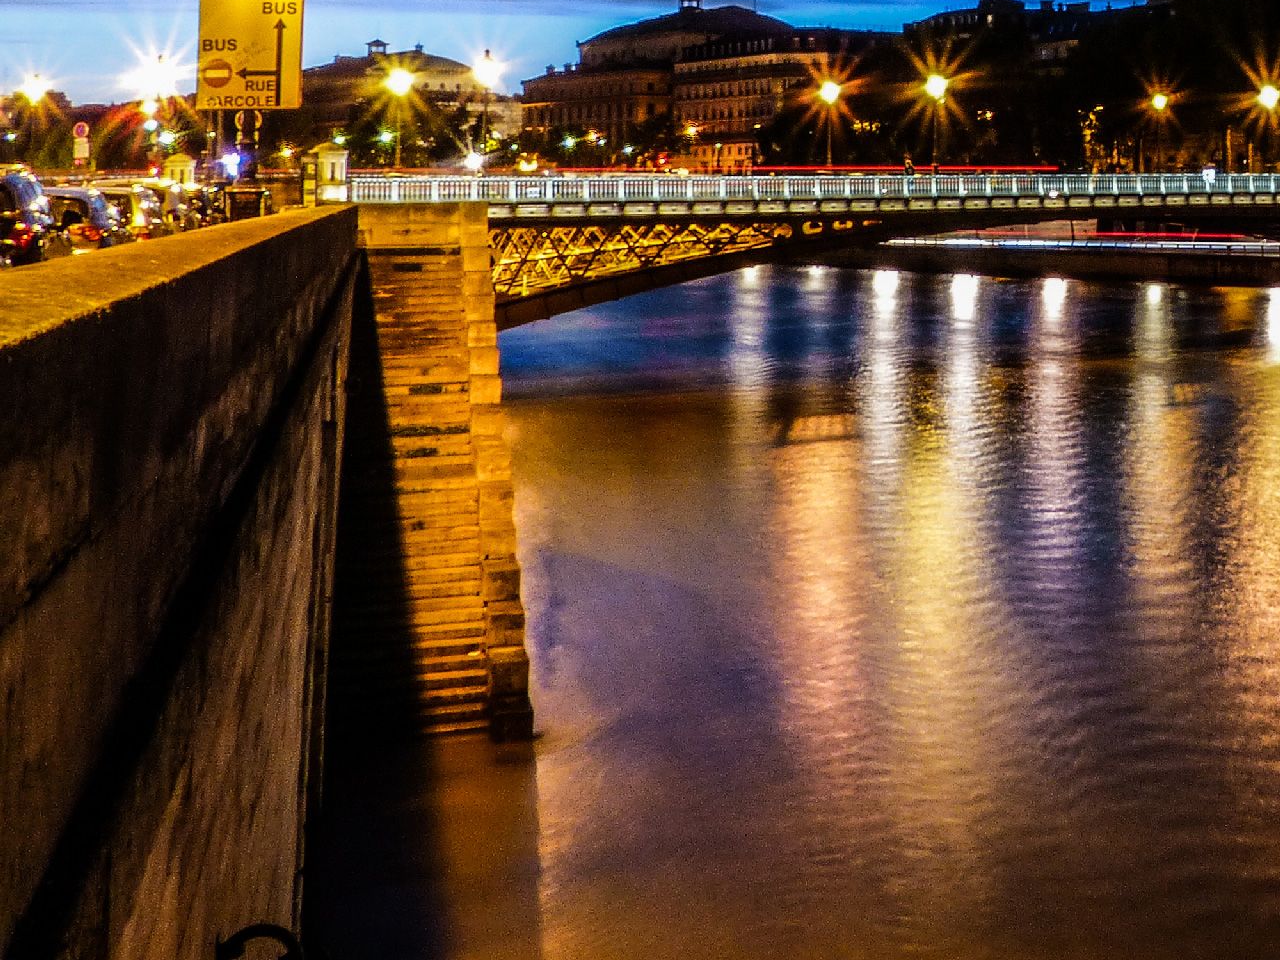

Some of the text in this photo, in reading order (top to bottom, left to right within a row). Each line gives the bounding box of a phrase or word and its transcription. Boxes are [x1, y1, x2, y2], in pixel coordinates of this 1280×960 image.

[262, 2, 297, 14] BUS
[202, 39, 238, 51] BUS
[245, 80, 275, 91] RUE
